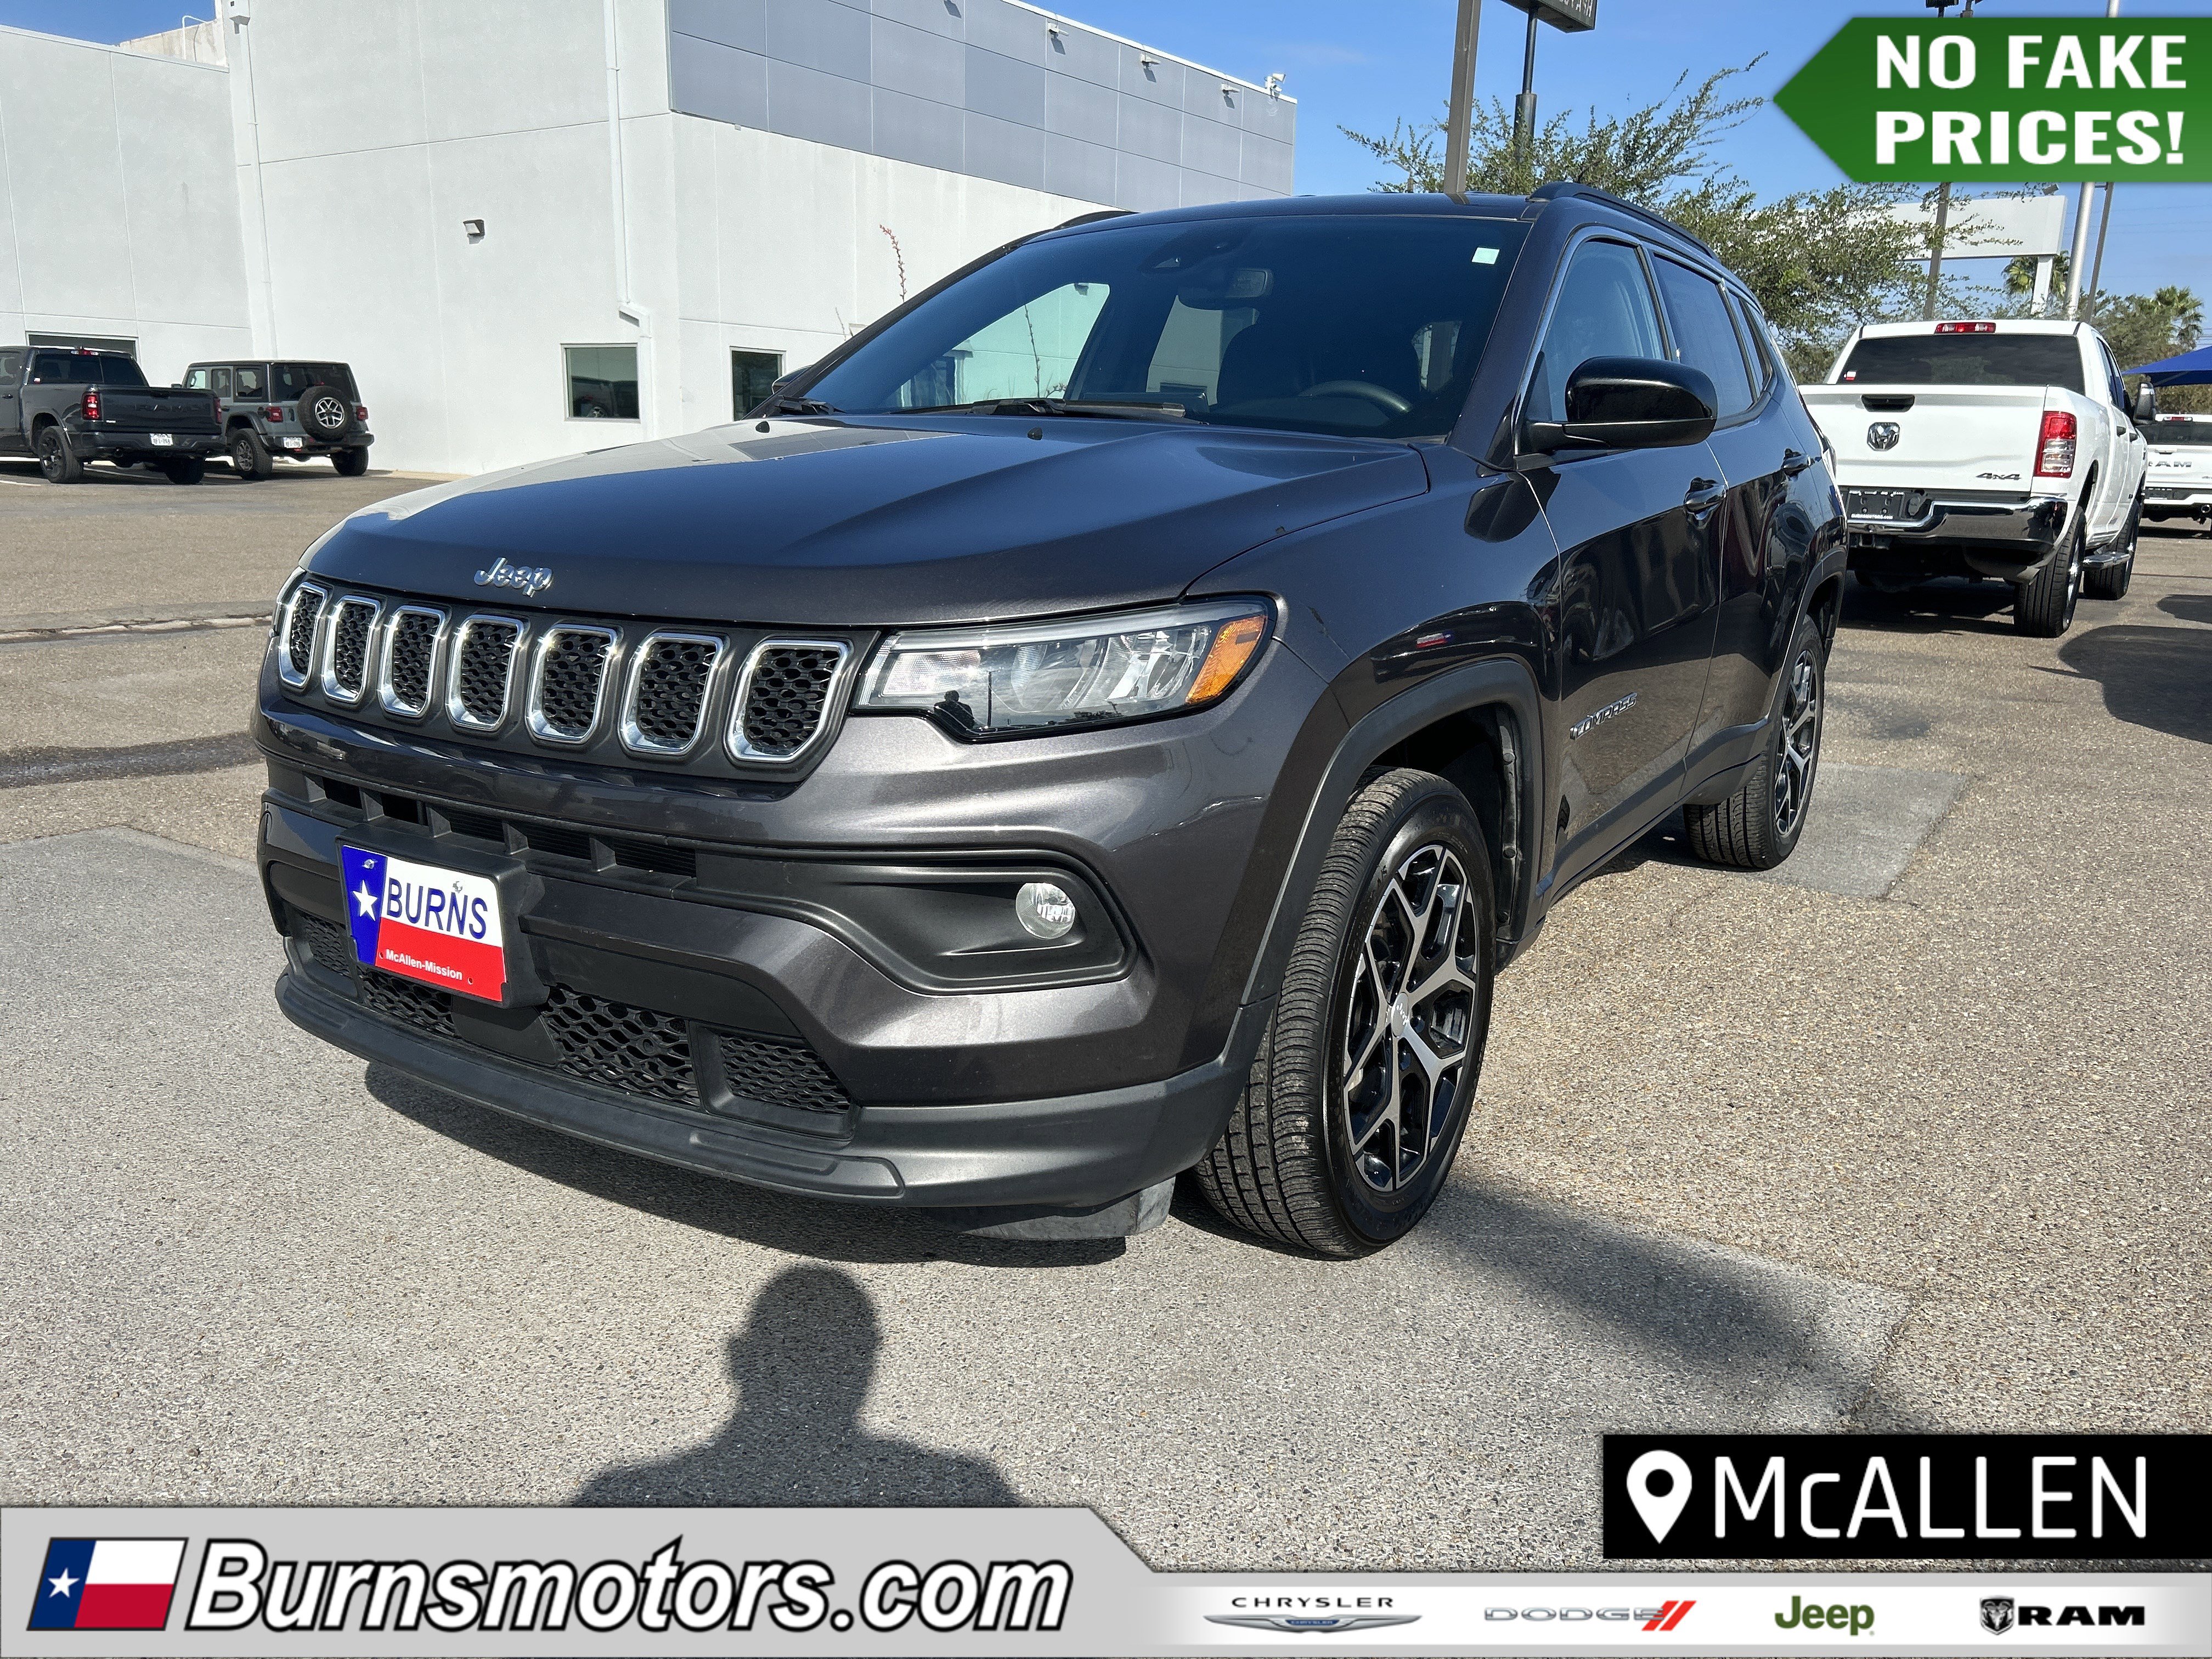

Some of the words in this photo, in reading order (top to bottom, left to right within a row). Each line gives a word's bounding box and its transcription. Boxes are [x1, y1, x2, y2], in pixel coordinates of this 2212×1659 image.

[474, 557, 554, 598] Jeep
[1570, 692, 1638, 740] COMPASS
[386, 877, 488, 940] BURNS
[386, 949, 462, 981] McAllen-Mission
